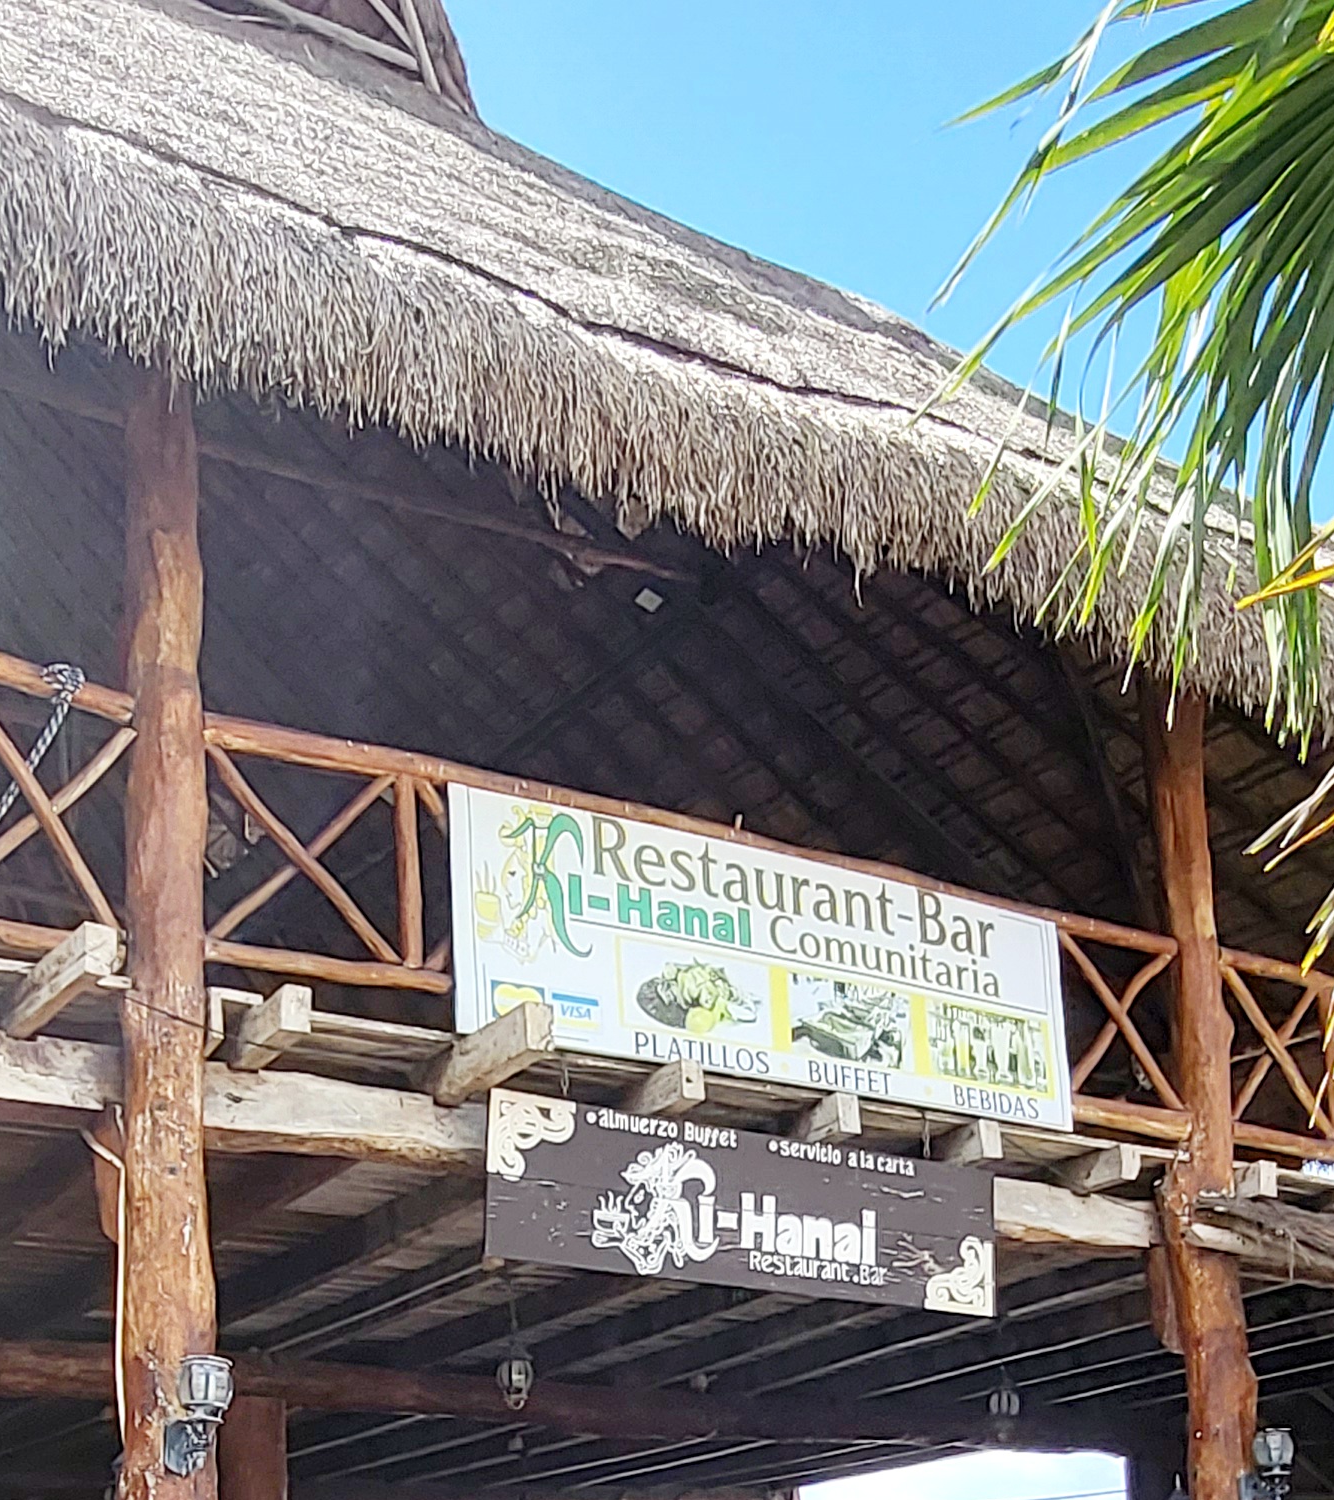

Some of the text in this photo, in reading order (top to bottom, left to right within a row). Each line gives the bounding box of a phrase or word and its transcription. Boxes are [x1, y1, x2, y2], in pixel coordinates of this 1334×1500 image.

[591, 814, 996, 959] Restaurant-Bar
[769, 914, 1001, 999] Comunitaria
[560, 1003, 592, 1020] VISA
[634, 1031, 1040, 1120] PLATILLOS BUFFET BEBIDAS
[598, 1108, 738, 1148] almuerzo Buffet
[779, 1139, 915, 1177] servicio a la carta
